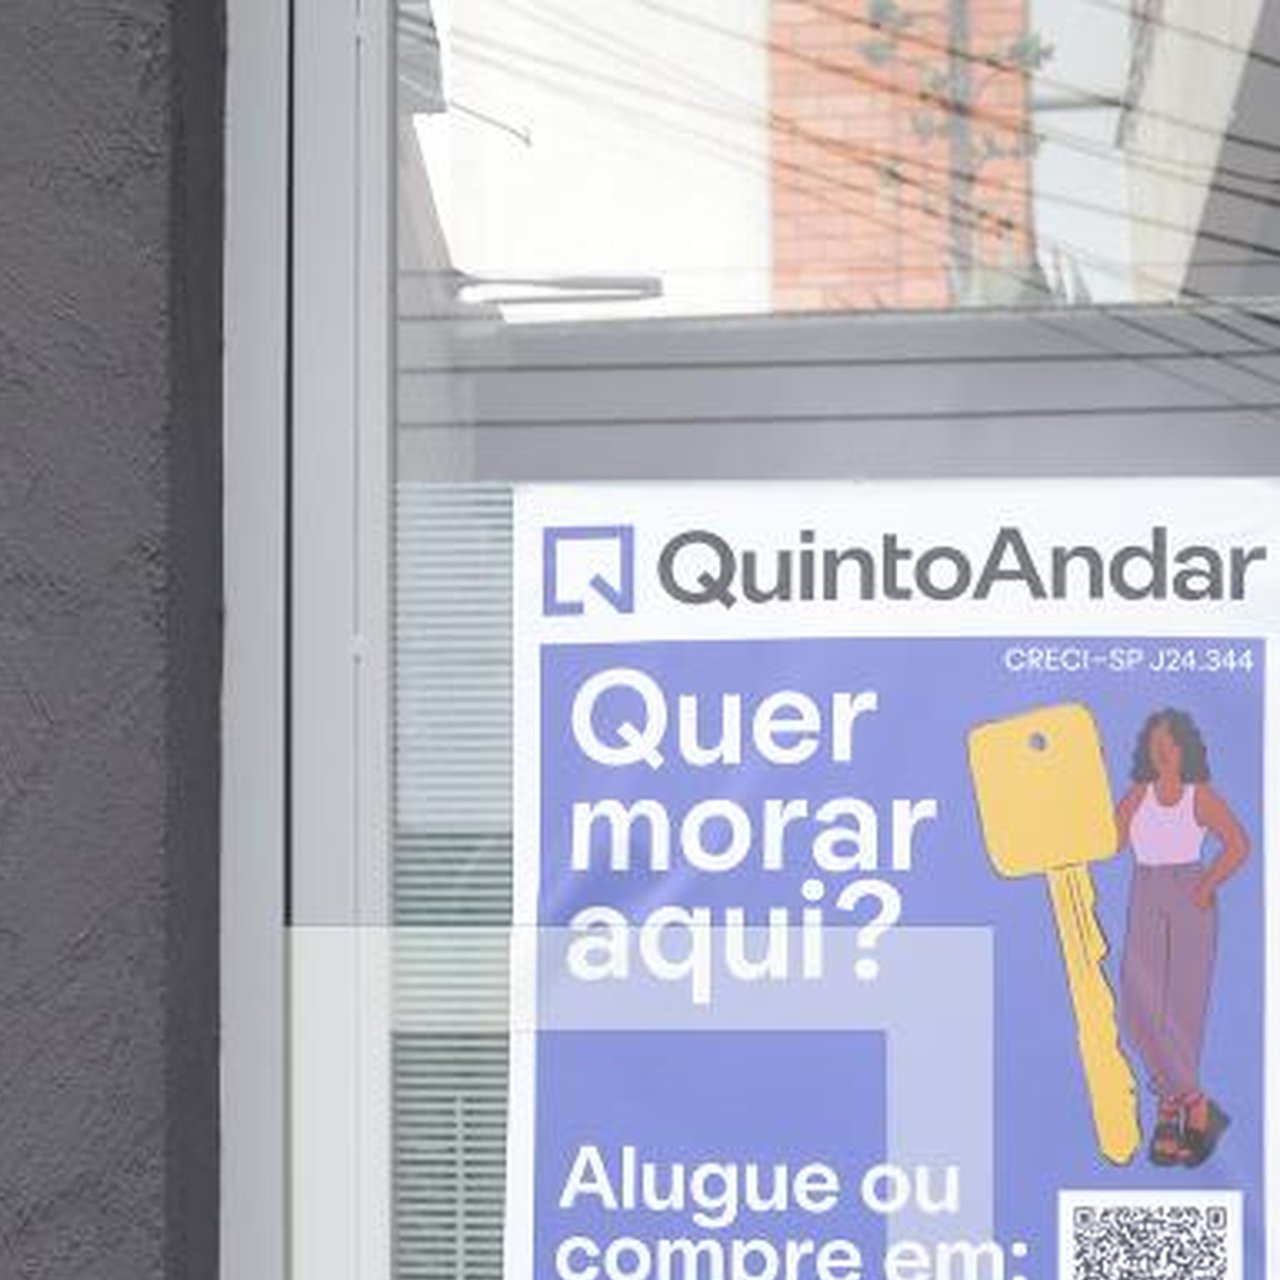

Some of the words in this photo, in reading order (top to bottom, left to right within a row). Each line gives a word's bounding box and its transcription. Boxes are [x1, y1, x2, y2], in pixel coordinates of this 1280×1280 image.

[658, 526, 1267, 610] QuintoAndar
[1004, 648, 1143, 673] CRECI-SP
[1150, 648, 1255, 673] J24.344
[571, 667, 878, 771] Quer
[569, 795, 937, 874] morar
[565, 880, 904, 1004] aqui?
[558, 1144, 840, 1229] Alugue
[860, 1161, 961, 1212] ou
